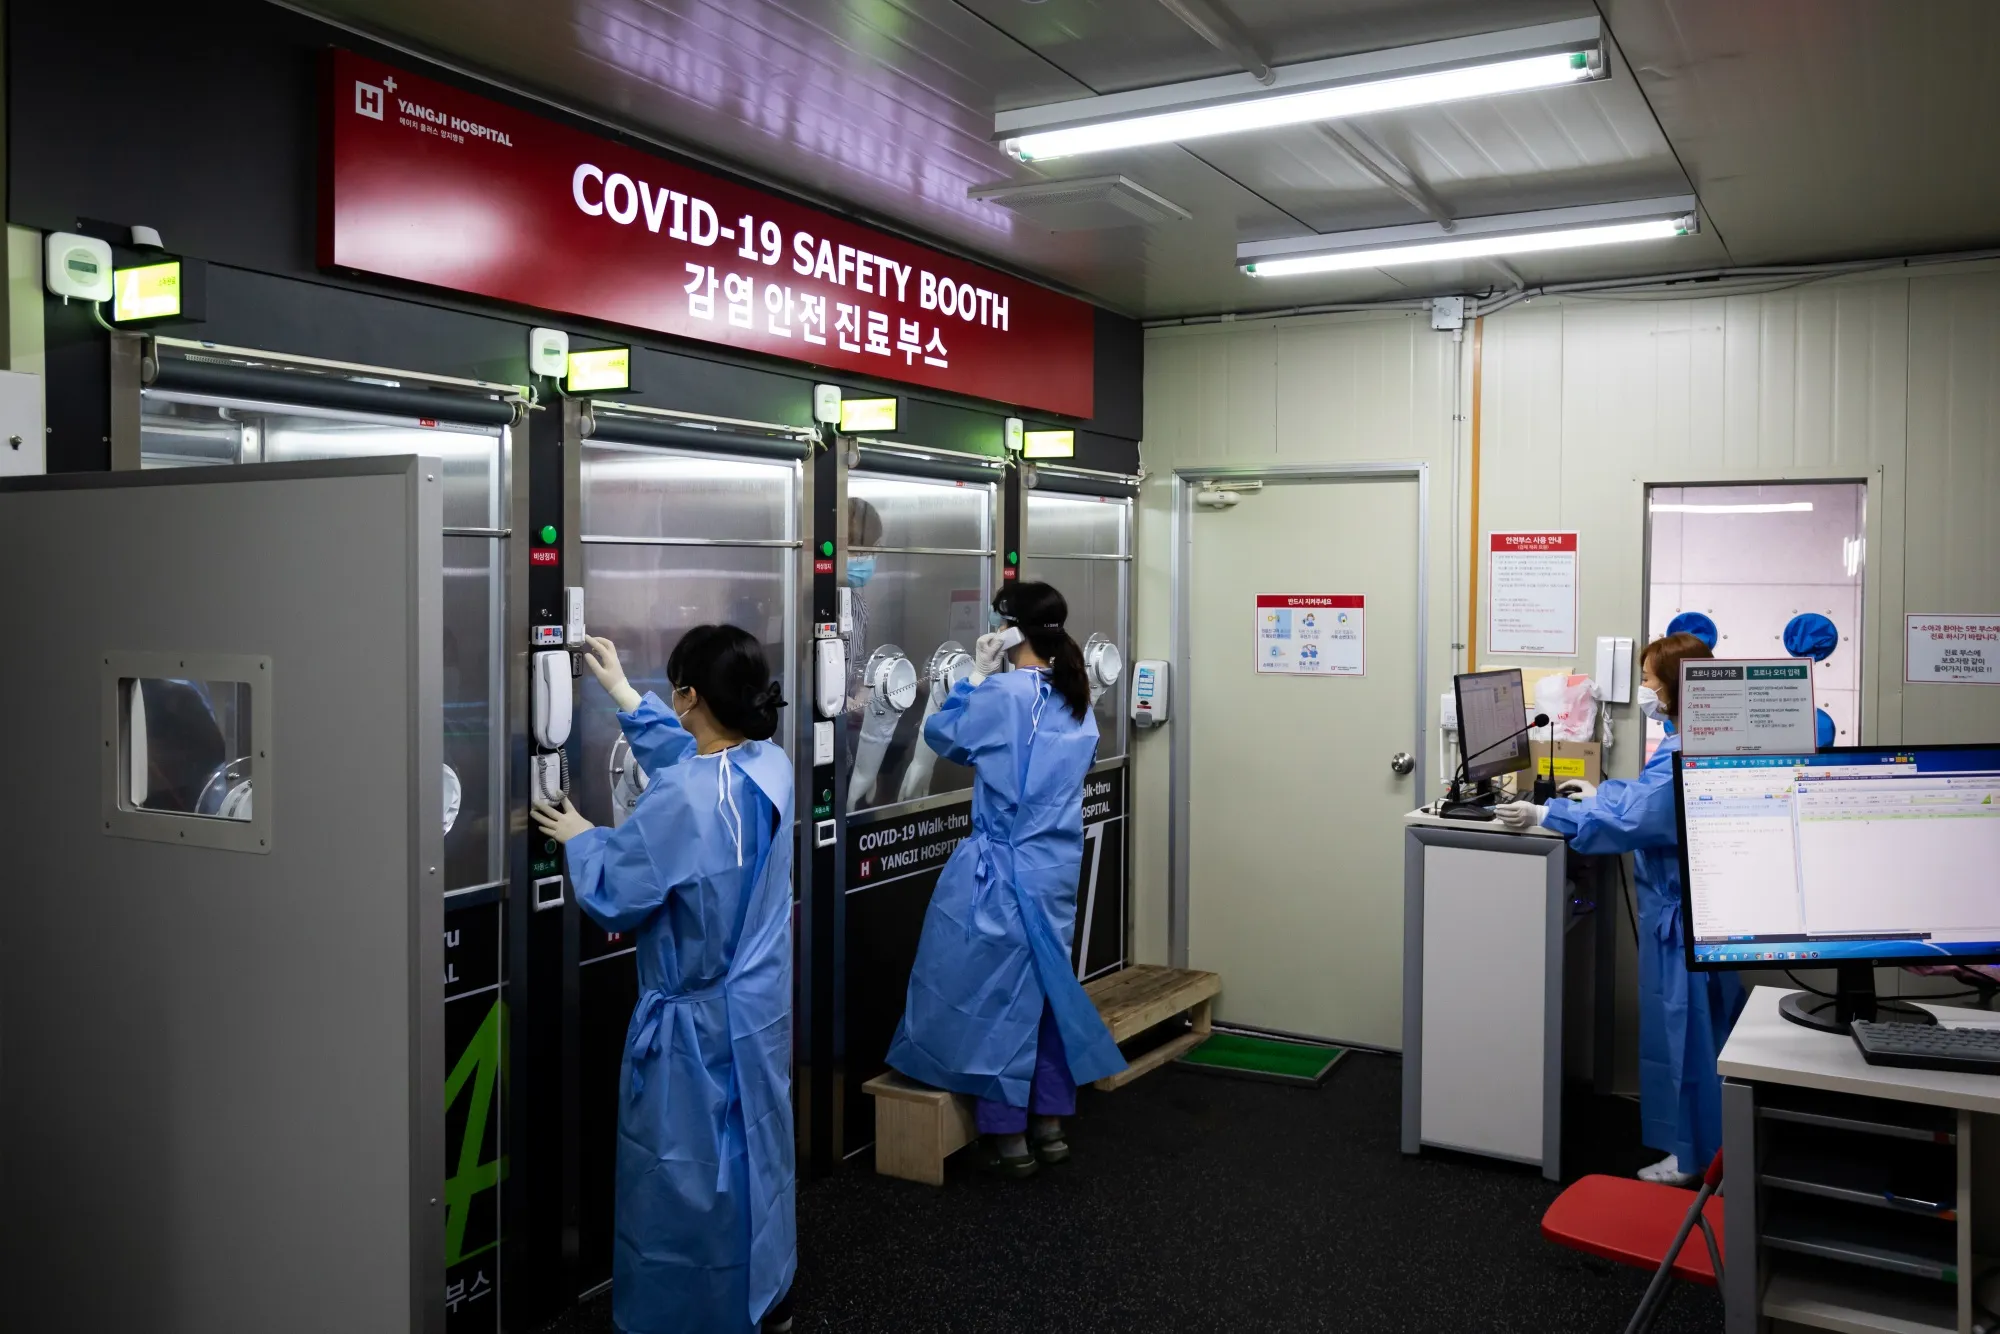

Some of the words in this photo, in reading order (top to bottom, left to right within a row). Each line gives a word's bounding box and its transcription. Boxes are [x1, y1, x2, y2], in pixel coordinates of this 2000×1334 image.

[398, 98, 447, 126] YANGJI
[451, 115, 513, 147] HOSPITAL
[572, 163, 782, 266] COVID-19
[793, 231, 912, 303] SAFETY
[920, 270, 1009, 332] BOOTH
[684, 262, 753, 330] 감염
[764, 283, 827, 346] 안전
[1505, 536, 1532, 545] 안전부스
[1533, 536, 1546, 545] 사용
[1548, 536, 1562, 545] 안내
[533, 552, 556, 561] 비상정지
[1287, 598, 1304, 606] 반드시
[1305, 598, 1332, 606] 지켜주세요
[1920, 624, 1941, 633] 소아과
[1966, 625, 1977, 633] 5번
[1930, 633, 1944, 641] 진료
[1946, 633, 1967, 641] 하시기
[1944, 649, 1958, 657] 진료
[1959, 649, 1982, 657] 부스에
[1970, 658, 1985, 666] 같이
[1691, 669, 1710, 678] 코로나
[1710, 669, 1724, 678] 검사
[1724, 669, 1737, 678] 기준
[1752, 668, 1772, 677] 코로나
[1773, 668, 1786, 677] 오더
[1787, 668, 1800, 677] 입력
[1934, 665, 1962, 673] 들어가지
[1082, 781, 1111, 798] alk-thru
[1081, 801, 1111, 819] OSPITAL
[859, 825, 916, 851] COVID-19
[918, 813, 969, 837] Walk-thru
[880, 848, 918, 871] YANGJI
[921, 836, 965, 861] HOSPIT
